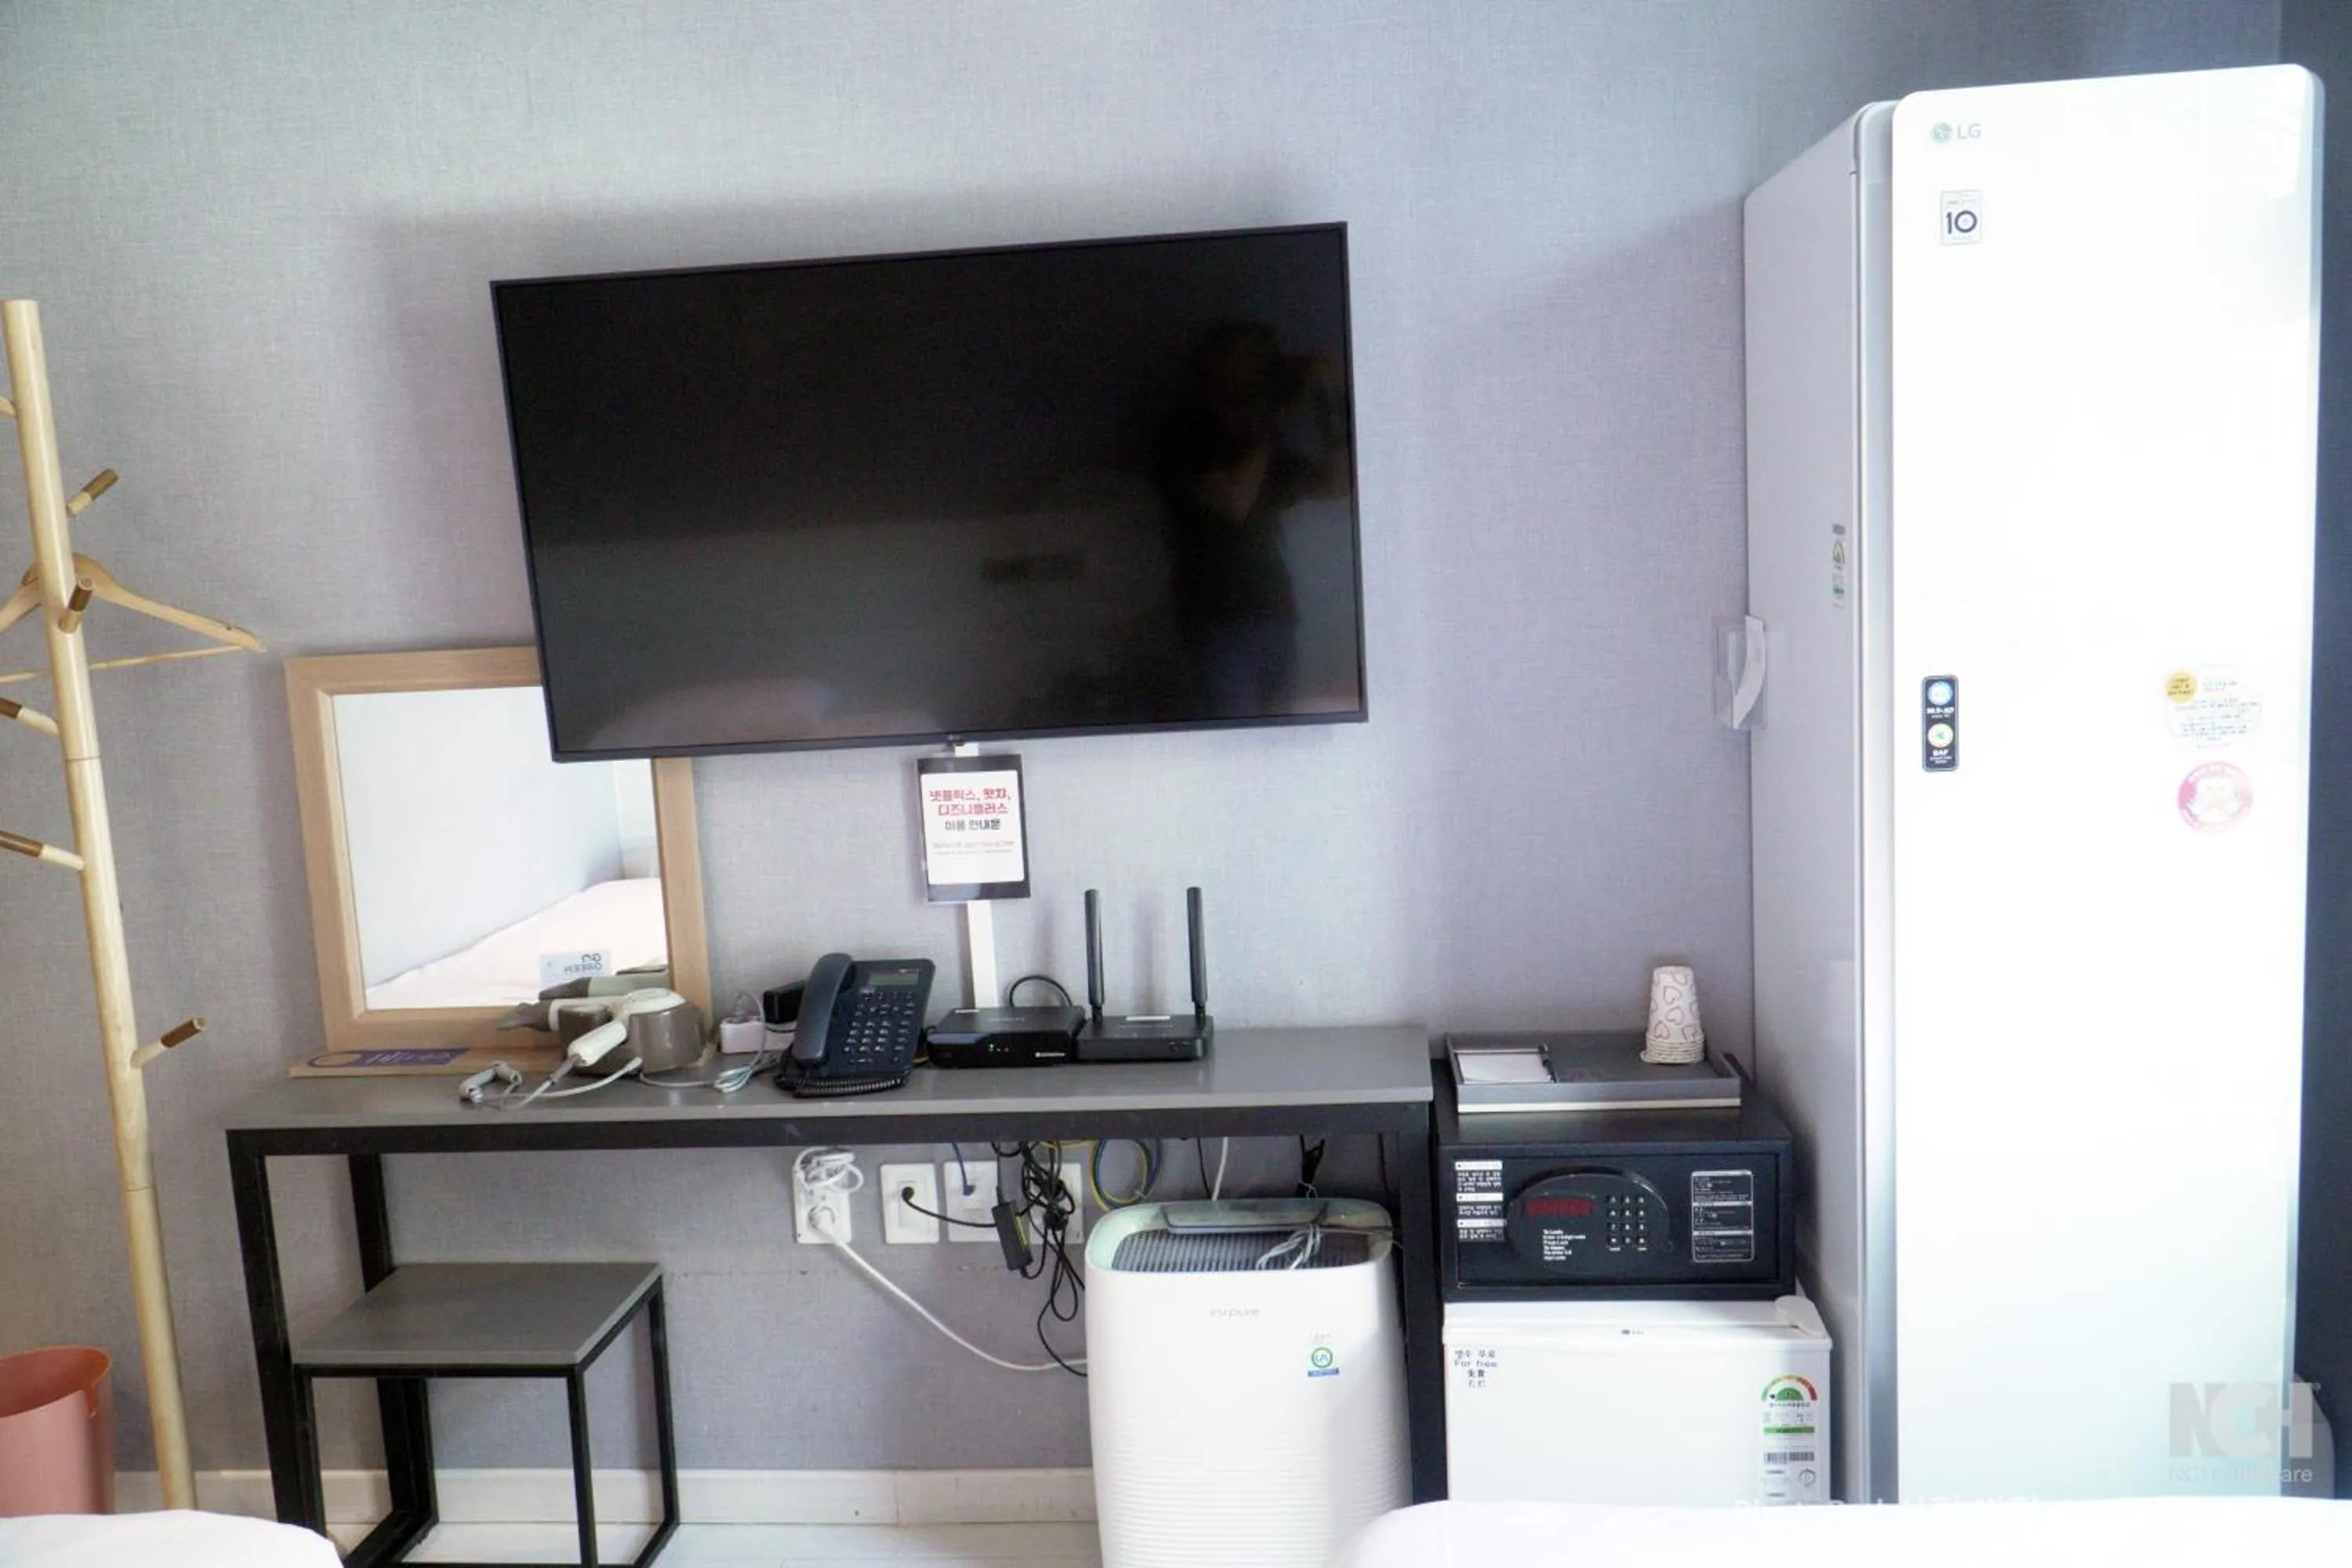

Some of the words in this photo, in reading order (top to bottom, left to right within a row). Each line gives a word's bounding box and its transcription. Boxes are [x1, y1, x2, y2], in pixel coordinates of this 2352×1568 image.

[1957, 123, 1981, 139] LG
[1946, 210, 1977, 234] 10
[938, 804, 1009, 816] 디즈니플러스
